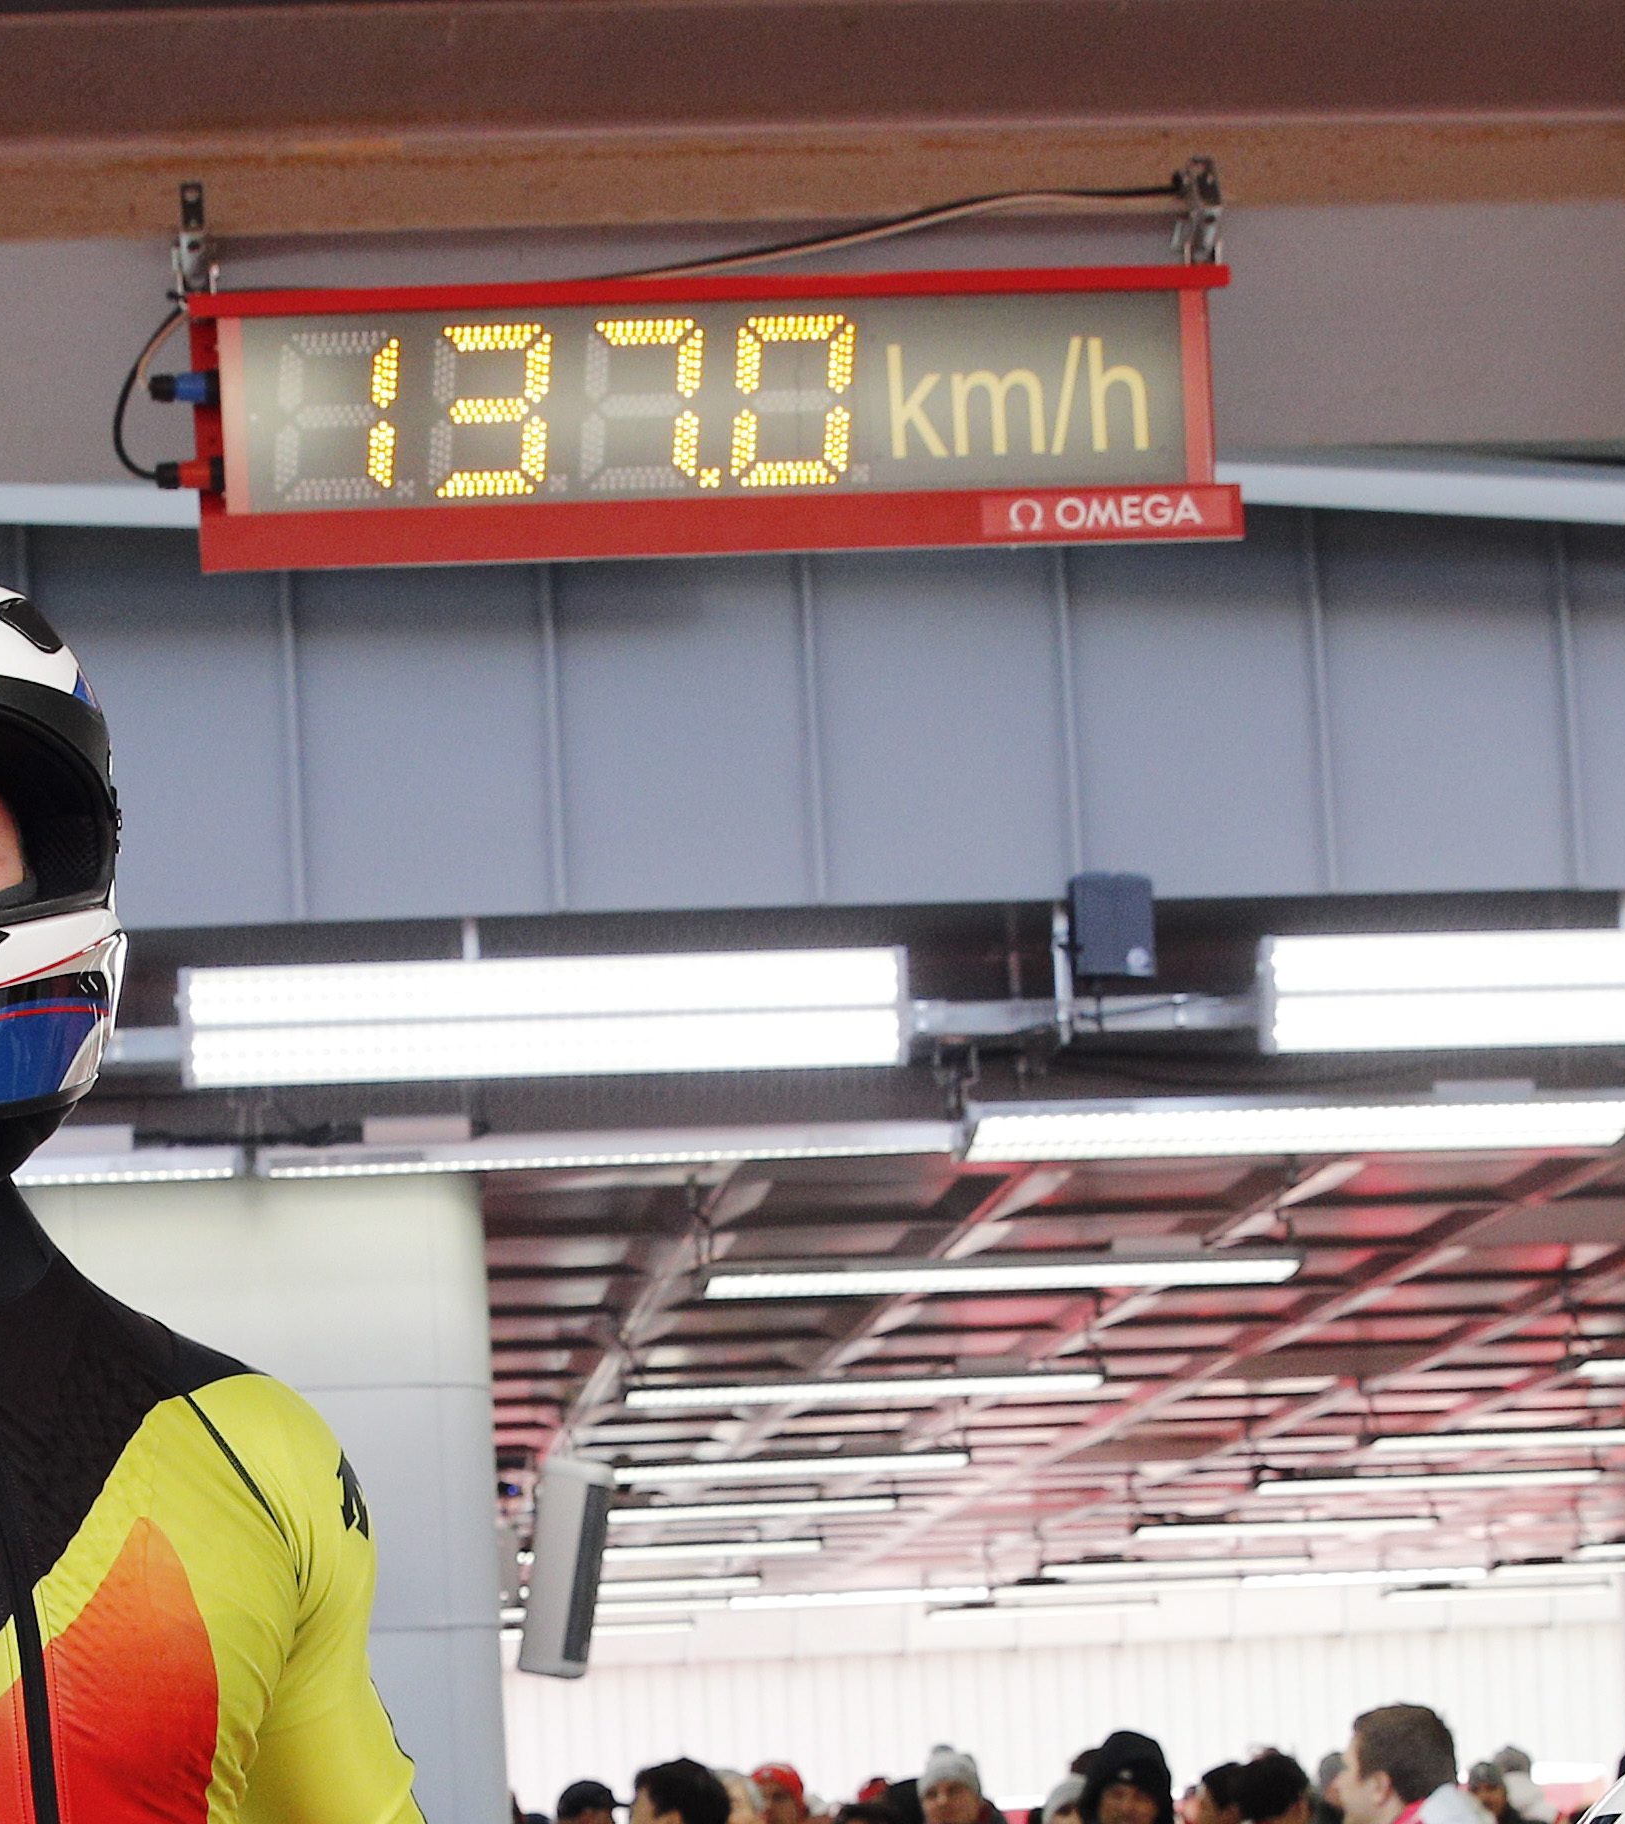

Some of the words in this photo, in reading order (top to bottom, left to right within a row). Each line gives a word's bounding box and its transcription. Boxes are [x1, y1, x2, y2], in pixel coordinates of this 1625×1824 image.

[367, 312, 855, 499] 137.0
[885, 335, 1150, 461] km/h
[1054, 493, 1203, 530] OMEGA
